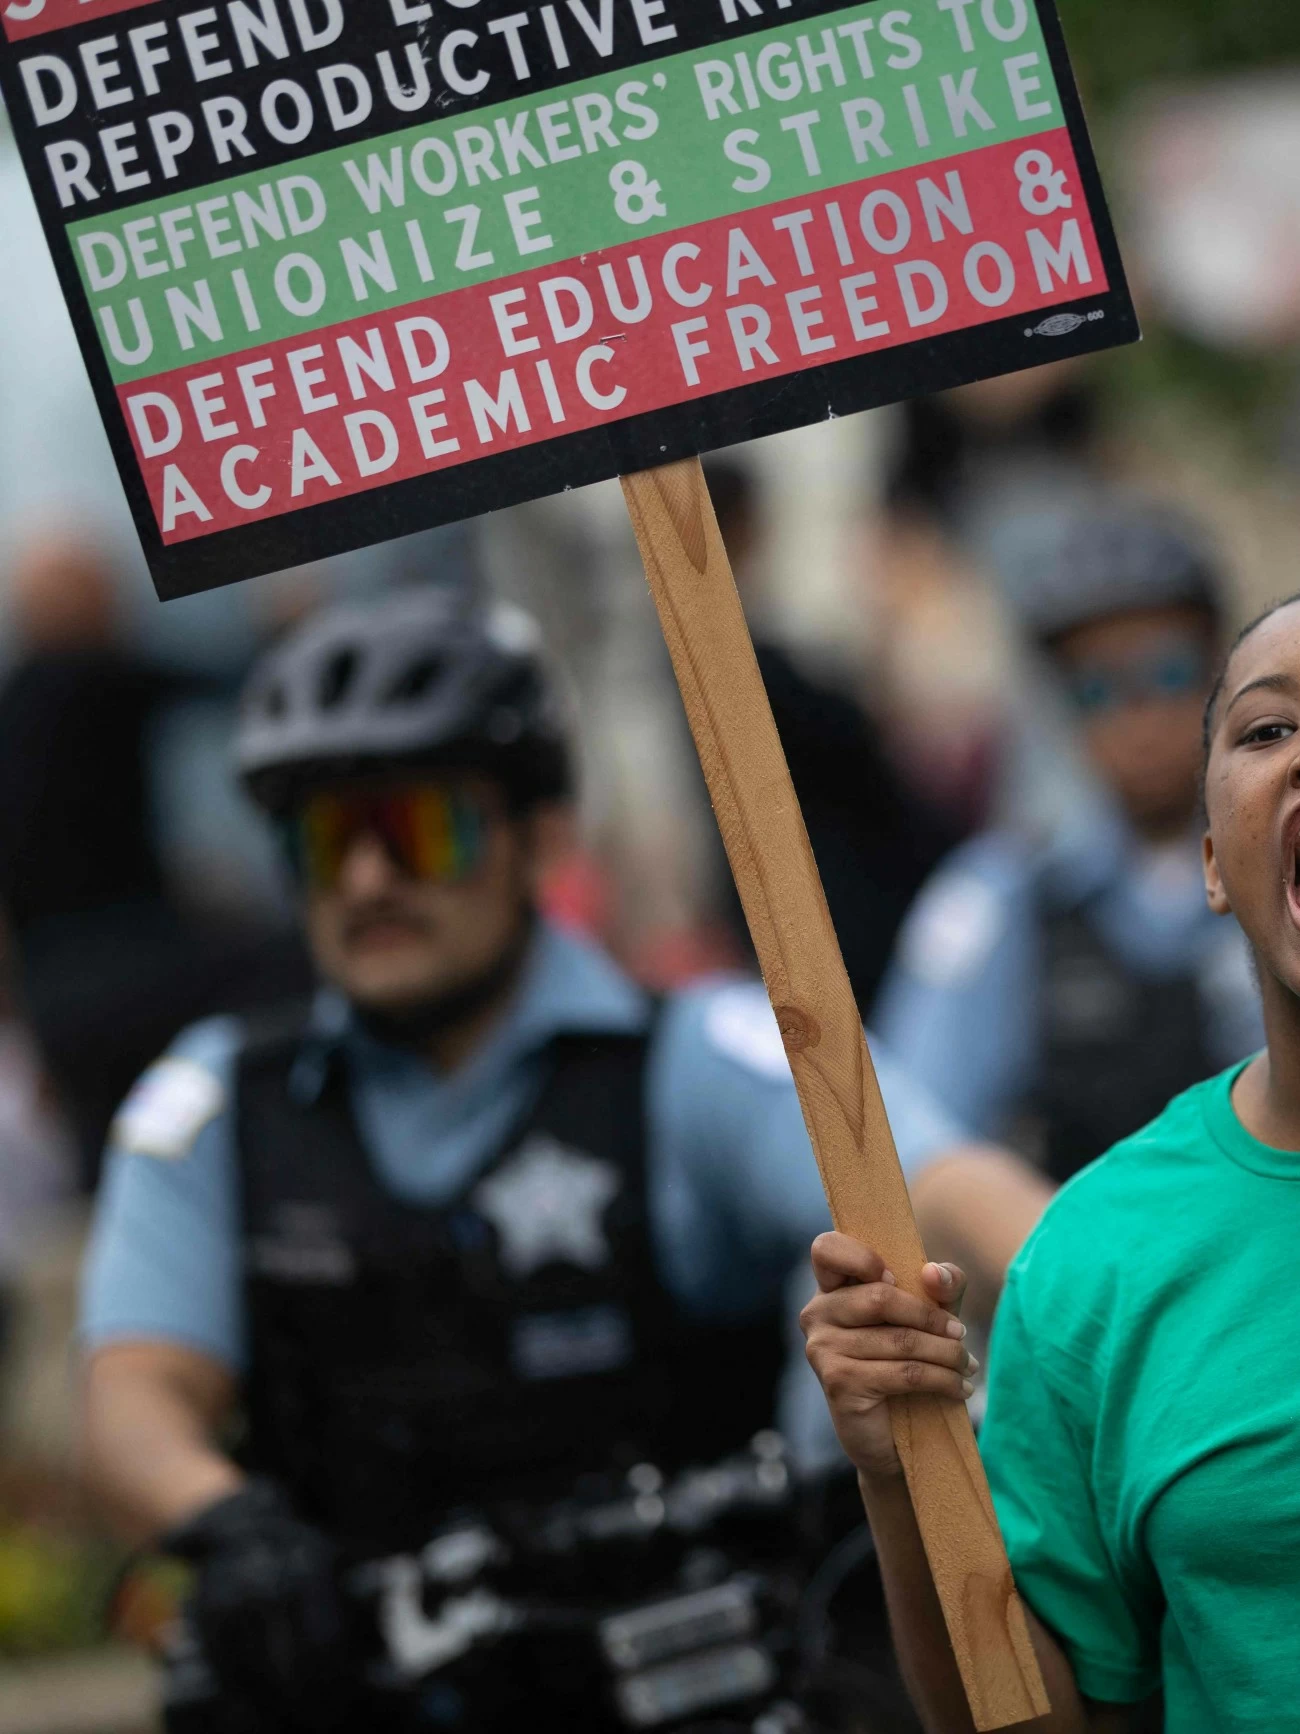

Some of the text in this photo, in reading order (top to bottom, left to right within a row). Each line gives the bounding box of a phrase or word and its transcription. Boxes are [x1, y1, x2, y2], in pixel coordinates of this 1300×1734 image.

[18, 0, 345, 127] DEFEND
[44, 0, 678, 207] REPRODUCTIVE
[76, 0, 1028, 292] DEFEND WORKERS’ RIGHTS TO
[98, 53, 1053, 365] UNIONIZE & STRIKE
[126, 149, 1073, 458] DEFEND EDUCATION &
[162, 218, 1093, 532] ACADEMIC FREEDOM
